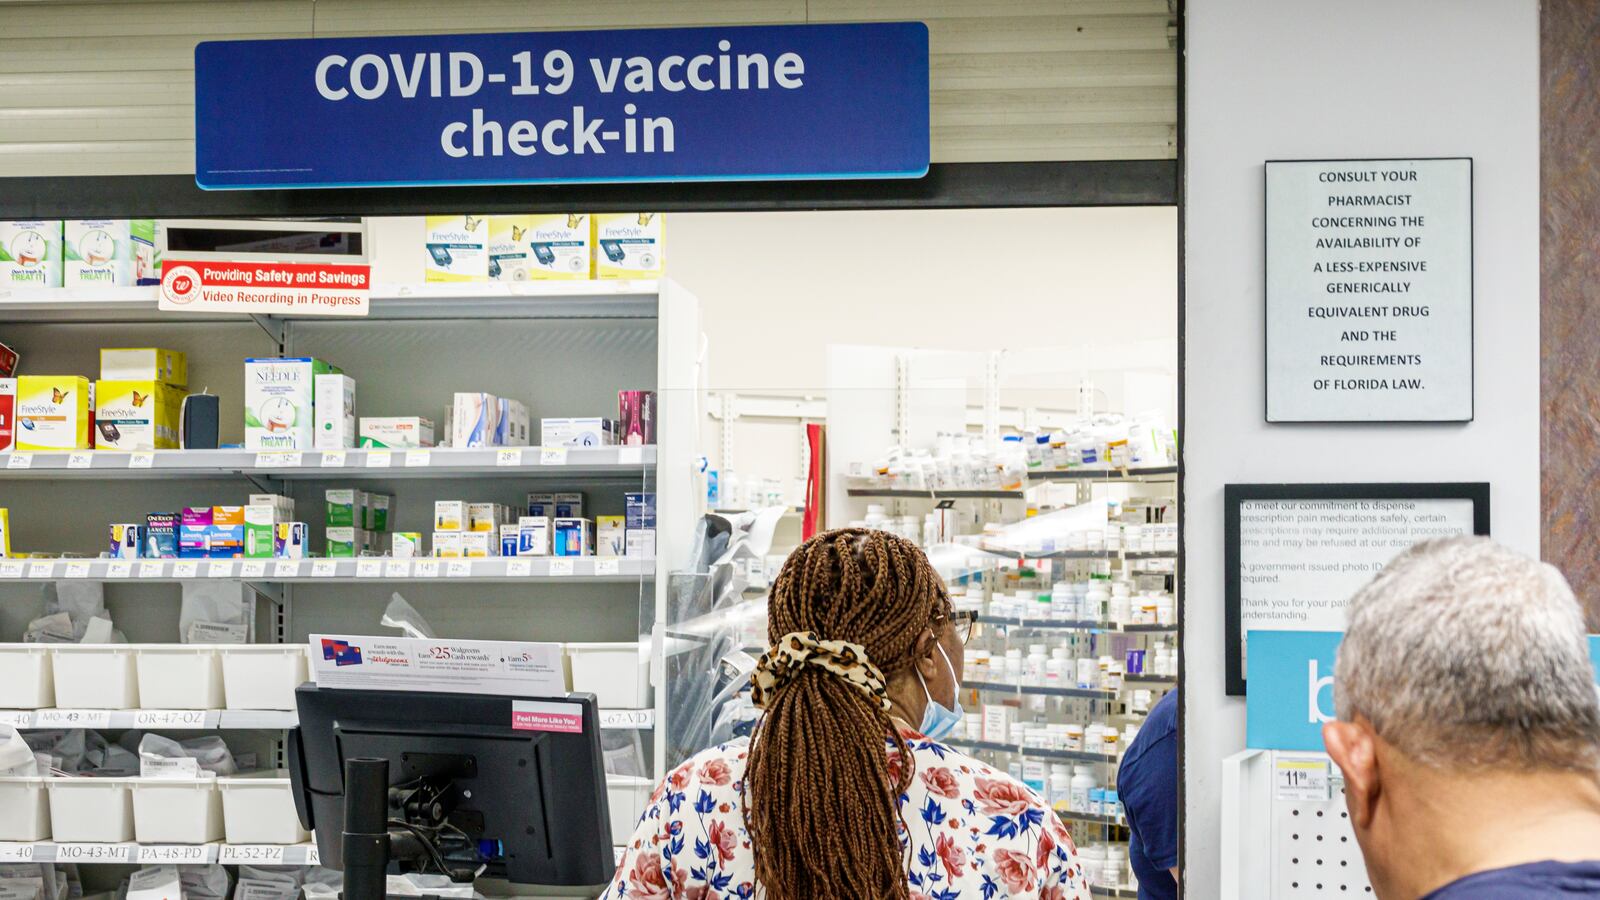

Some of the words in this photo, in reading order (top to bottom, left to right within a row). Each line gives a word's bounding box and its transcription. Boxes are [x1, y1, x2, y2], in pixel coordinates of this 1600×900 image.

[315, 49, 574, 101] COVID-19
[589, 39, 805, 93] vaccine
[440, 103, 675, 157] check-in
[1319, 171, 1377, 182] CONSULT
[1381, 171, 1417, 181] YOUR
[1328, 195, 1412, 206] PHARMACIST
[1312, 217, 1397, 228] CONCERNING
[1401, 216, 1424, 227] THE
[432, 232, 469, 242] FreeStyle
[536, 230, 572, 240] FreeStyle
[605, 228, 642, 237] FreeStyle
[1315, 238, 1400, 248] AVAILABILITY
[1404, 237, 1421, 248] OF
[1313, 262, 1322, 272] A
[1326, 261, 1427, 272] LESS-EXPENSIVE
[203, 268, 253, 284] Providing
[255, 269, 294, 286] Safety
[296, 271, 316, 284] and
[318, 271, 366, 286] Savings
[1326, 282, 1410, 293] GENERICALLY
[202, 290, 234, 302] Video
[238, 292, 294, 306] Recording
[298, 292, 308, 304] in
[312, 294, 361, 306] Progress
[1308, 306, 1388, 318] EQUIVALENT
[1392, 306, 1430, 317] DRUG
[1340, 330, 1369, 341] AND
[1373, 330, 1397, 341] THE
[1320, 355, 1422, 367] REQUIREMENTS
[1313, 380, 1330, 390] OF
[1334, 379, 1388, 390] FLORIDA
[1392, 378, 1425, 390] LAW.
[22, 404, 56, 414] FreeStyle
[102, 408, 136, 418] FreeStyle
[1240, 501, 1252, 510] To
[1254, 502, 1278, 510] meet
[1300, 502, 1358, 510] commitment
[1360, 502, 1370, 510] to
[1372, 502, 1415, 512] dispense
[1240, 514, 1294, 524] prescription
[1297, 514, 1318, 524] pain
[1320, 514, 1378, 523] medications
[1380, 514, 1411, 524] safely,
[1414, 514, 1446, 523] certain
[1302, 528, 1322, 536] may
[1326, 526, 1358, 536] require
[1362, 526, 1408, 535] additional
[1410, 526, 1464, 536] processing
[1262, 538, 1280, 547] and
[1282, 540, 1302, 548] may
[1306, 538, 1320, 547] be
[1320, 538, 1356, 547] refused
[1240, 563, 1246, 572] A
[1249, 562, 1306, 573] government
[1308, 562, 1340, 572] issued
[1342, 562, 1369, 572] photo
[1372, 562, 1382, 572] ID
[1240, 598, 1268, 608] Thank
[1272, 600, 1289, 610] you
[1292, 598, 1304, 608] for
[1306, 600, 1328, 610] your
[430, 646, 450, 660] $25
[14, 714, 30, 725] 40
[138, 712, 202, 724] OR-47-OZ
[600, 714, 647, 725] -67-VD
[16, 847, 32, 858] 40
[60, 846, 128, 858] MO-43-MT
[140, 848, 202, 859] PA-48-PD
[224, 848, 281, 859] PL-52-PZ
